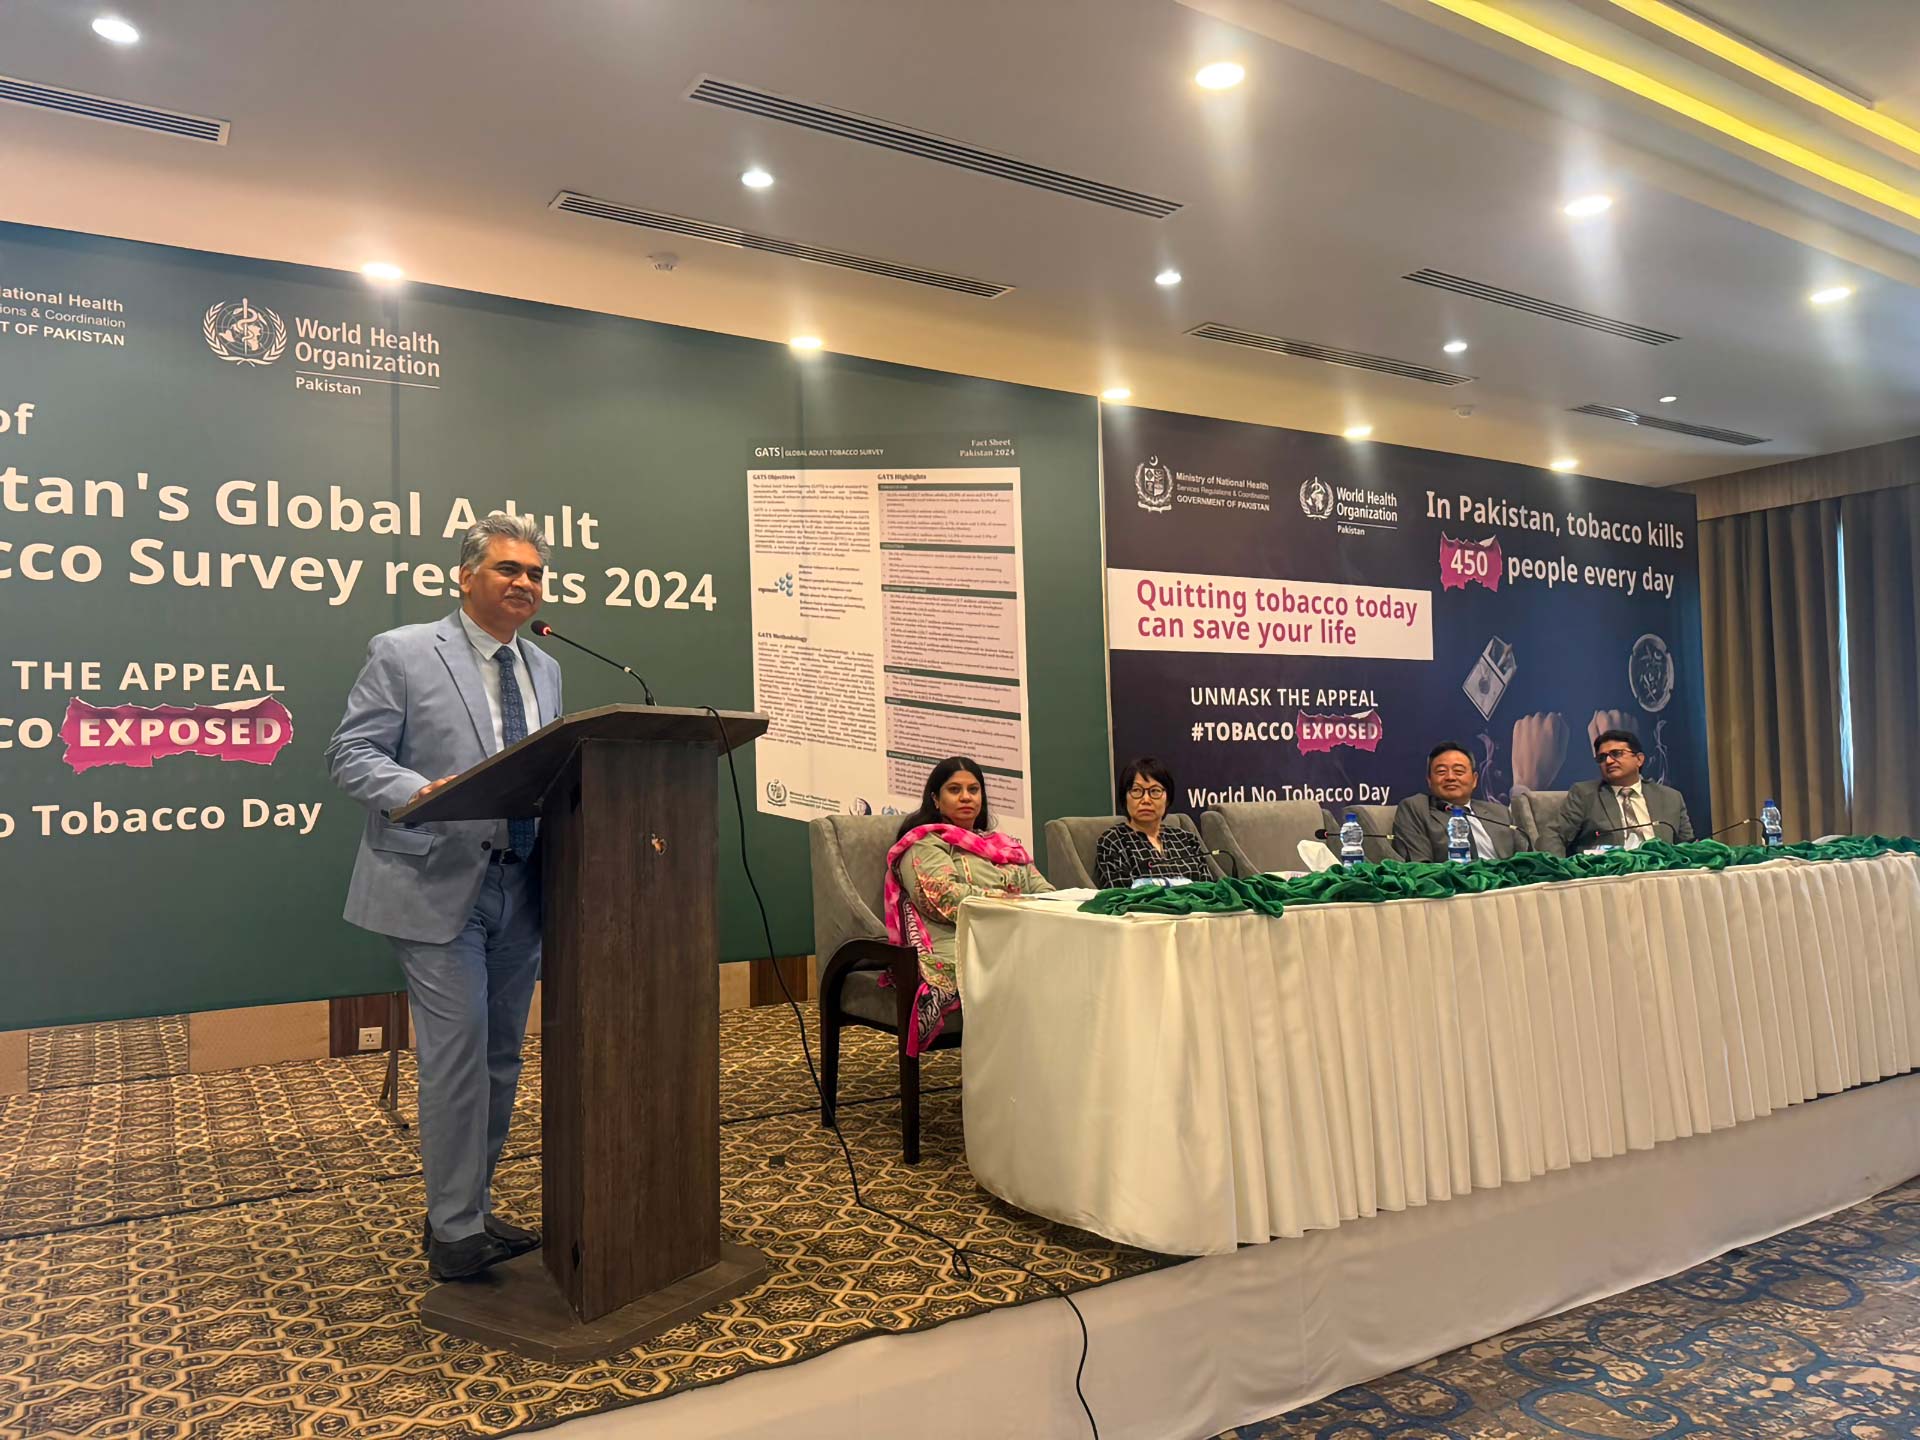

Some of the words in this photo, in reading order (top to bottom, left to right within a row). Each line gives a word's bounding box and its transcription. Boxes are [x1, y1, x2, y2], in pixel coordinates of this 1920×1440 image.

[0, 286, 63, 305] ational
[69, 293, 124, 312] Health
[31, 307, 40, 318] &
[45, 309, 126, 328] Coordination
[15, 323, 38, 336] OF
[43, 326, 125, 346] PAKISTAN
[295, 317, 361, 345] World
[370, 327, 440, 355] Health
[295, 341, 440, 378] Organization
[296, 376, 362, 396] Pakistan
[754, 446, 780, 458] GATS
[785, 448, 808, 457] GLOBAL
[808, 448, 828, 457] ADULT
[829, 448, 858, 457] TOBACCO
[859, 448, 884, 456] SURVEY
[959, 449, 993, 457] Pakistan
[994, 448, 1015, 456] 2024
[971, 439, 987, 447] Fact
[989, 438, 1011, 446] Sheet
[1176, 471, 1206, 485] Ministry
[1206, 476, 1215, 484] of
[1216, 476, 1245, 488] National
[1246, 480, 1269, 490] Health
[1176, 494, 1225, 507] GOVERNMENT
[1226, 500, 1236, 508] OF
[1237, 501, 1270, 511] PAKISTAN
[1336, 486, 1364, 503] World
[1367, 490, 1398, 507] Health
[215, 480, 421, 538] Global
[1336, 502, 1398, 522] Organization
[1426, 490, 1451, 520] In
[1459, 495, 1561, 537] Pakistan,
[1567, 511, 1642, 545] tobacco
[1648, 521, 1684, 549] kills
[1337, 524, 1365, 536] Pakistan
[129, 538, 363, 606] Survey
[386, 560, 587, 605] rests
[604, 566, 717, 612] 2024
[1450, 548, 1488, 577] 450
[1508, 555, 1578, 589] people
[1584, 565, 1637, 597] every
[1642, 566, 1674, 600] day
[1137, 579, 1247, 618] Quitting
[1255, 587, 1348, 616] tobacco
[1356, 594, 1418, 627] today
[1138, 616, 1184, 639] can
[1193, 618, 1250, 641] save
[1258, 621, 1313, 649] your
[1320, 619, 1357, 645] life
[12, 660, 101, 690] THE
[119, 661, 285, 692] APPEAL
[1190, 687, 1272, 706] UNMASK
[1277, 688, 1310, 706] THE
[1315, 689, 1379, 707] APPEAL
[79, 717, 282, 748] EXPOSED
[1191, 721, 1294, 742] #TOBACCO
[1302, 722, 1378, 740] EXPOSED
[1187, 786, 1245, 808] World
[1251, 786, 1277, 802] No
[1282, 783, 1354, 803] Tobacco
[1359, 783, 1390, 806] Day
[32, 801, 226, 836] Tobacco
[242, 798, 322, 835] Day
